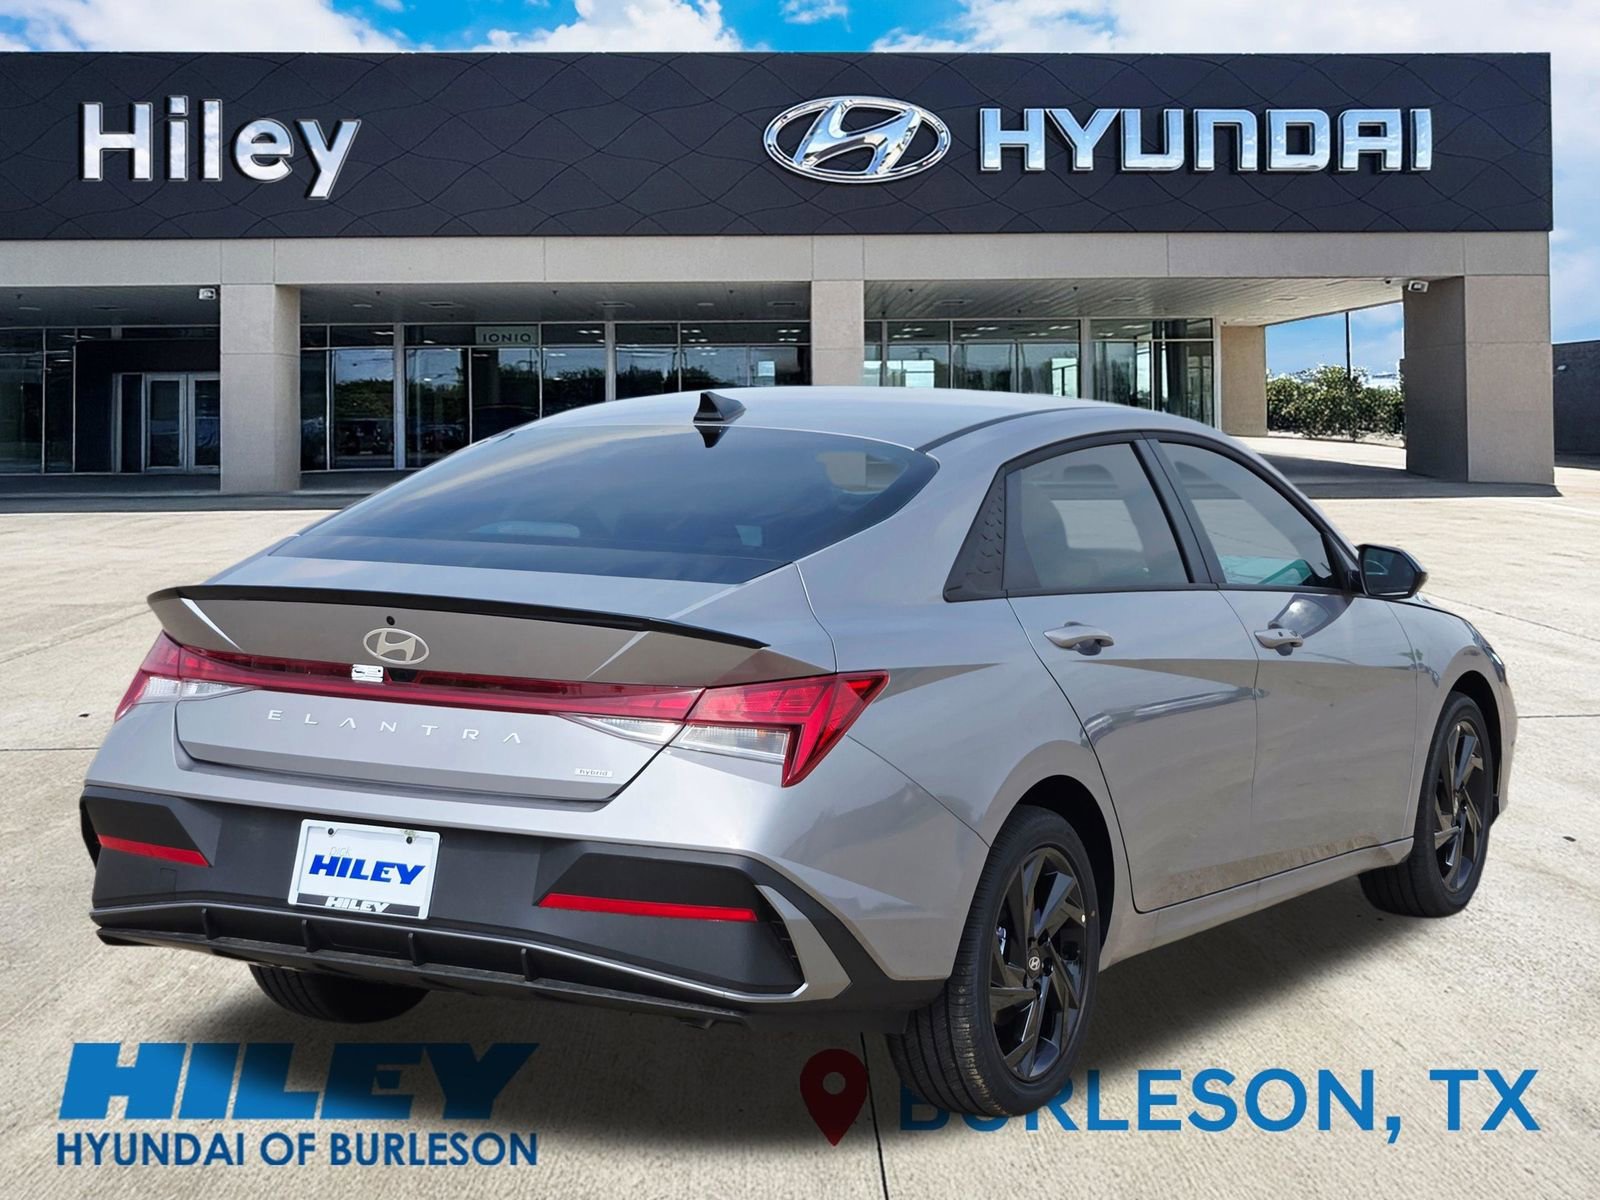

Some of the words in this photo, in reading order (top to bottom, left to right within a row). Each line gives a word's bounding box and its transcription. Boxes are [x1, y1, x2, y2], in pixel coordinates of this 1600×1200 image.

[78, 95, 361, 200] Hiley
[979, 107, 1432, 172] HYUNDAI
[482, 332, 532, 343] IONIQ
[268, 709, 522, 744] ELANTRA
[579, 768, 608, 777] hybrid
[308, 854, 426, 885] HILEY
[325, 896, 390, 913] HILEY
